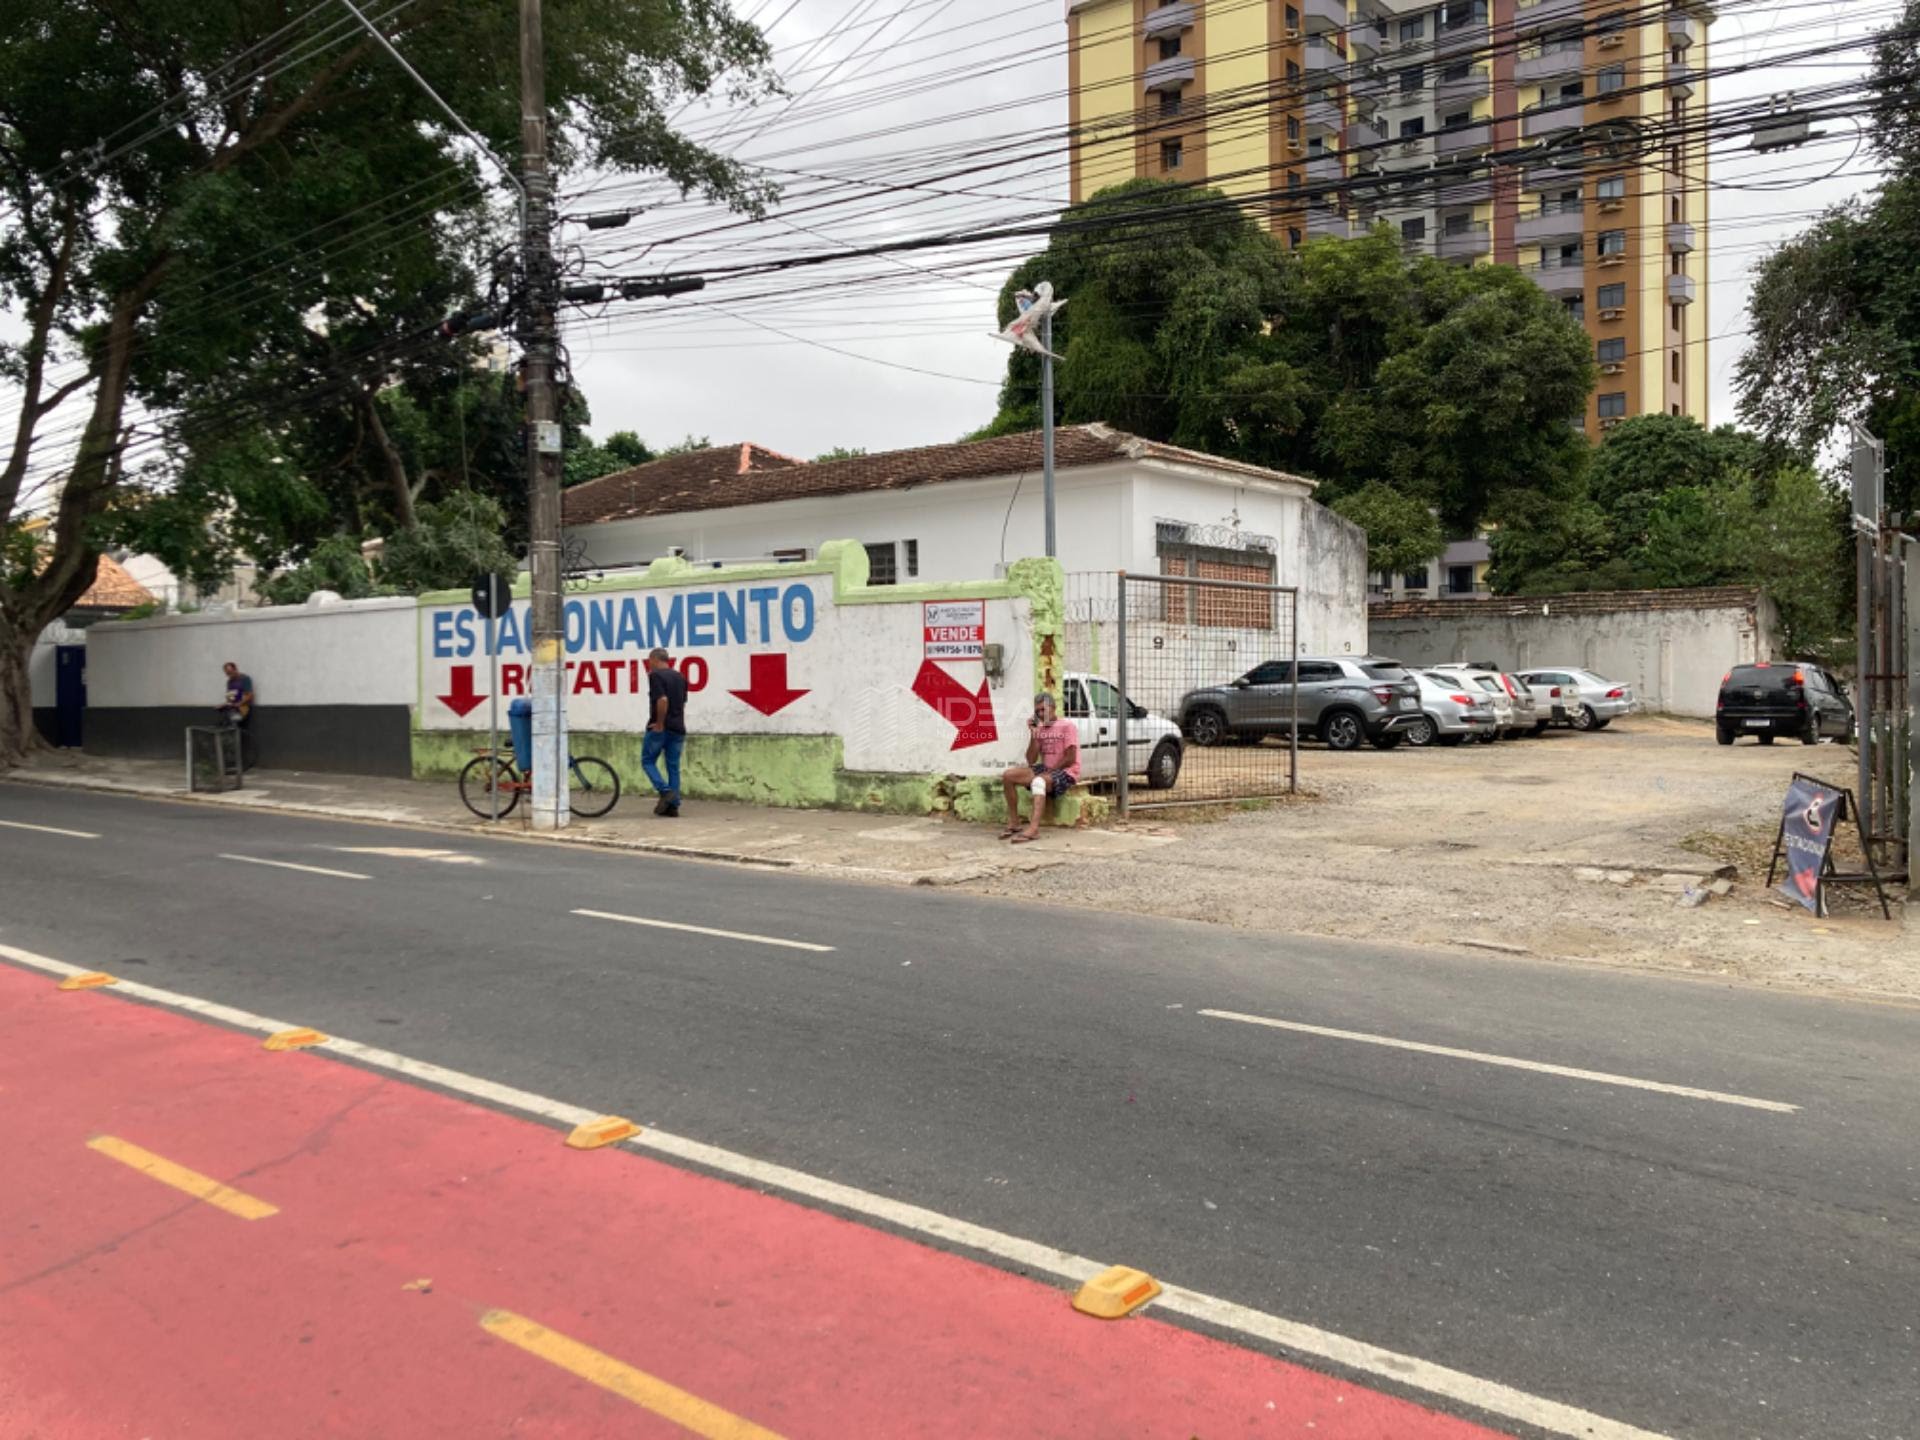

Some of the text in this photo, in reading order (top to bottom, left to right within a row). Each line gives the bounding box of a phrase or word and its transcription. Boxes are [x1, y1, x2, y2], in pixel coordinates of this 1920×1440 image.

[433, 584, 815, 658] ESAONAMENTO
[930, 627, 978, 641] VENDE
[502, 655, 709, 696] RATIO
